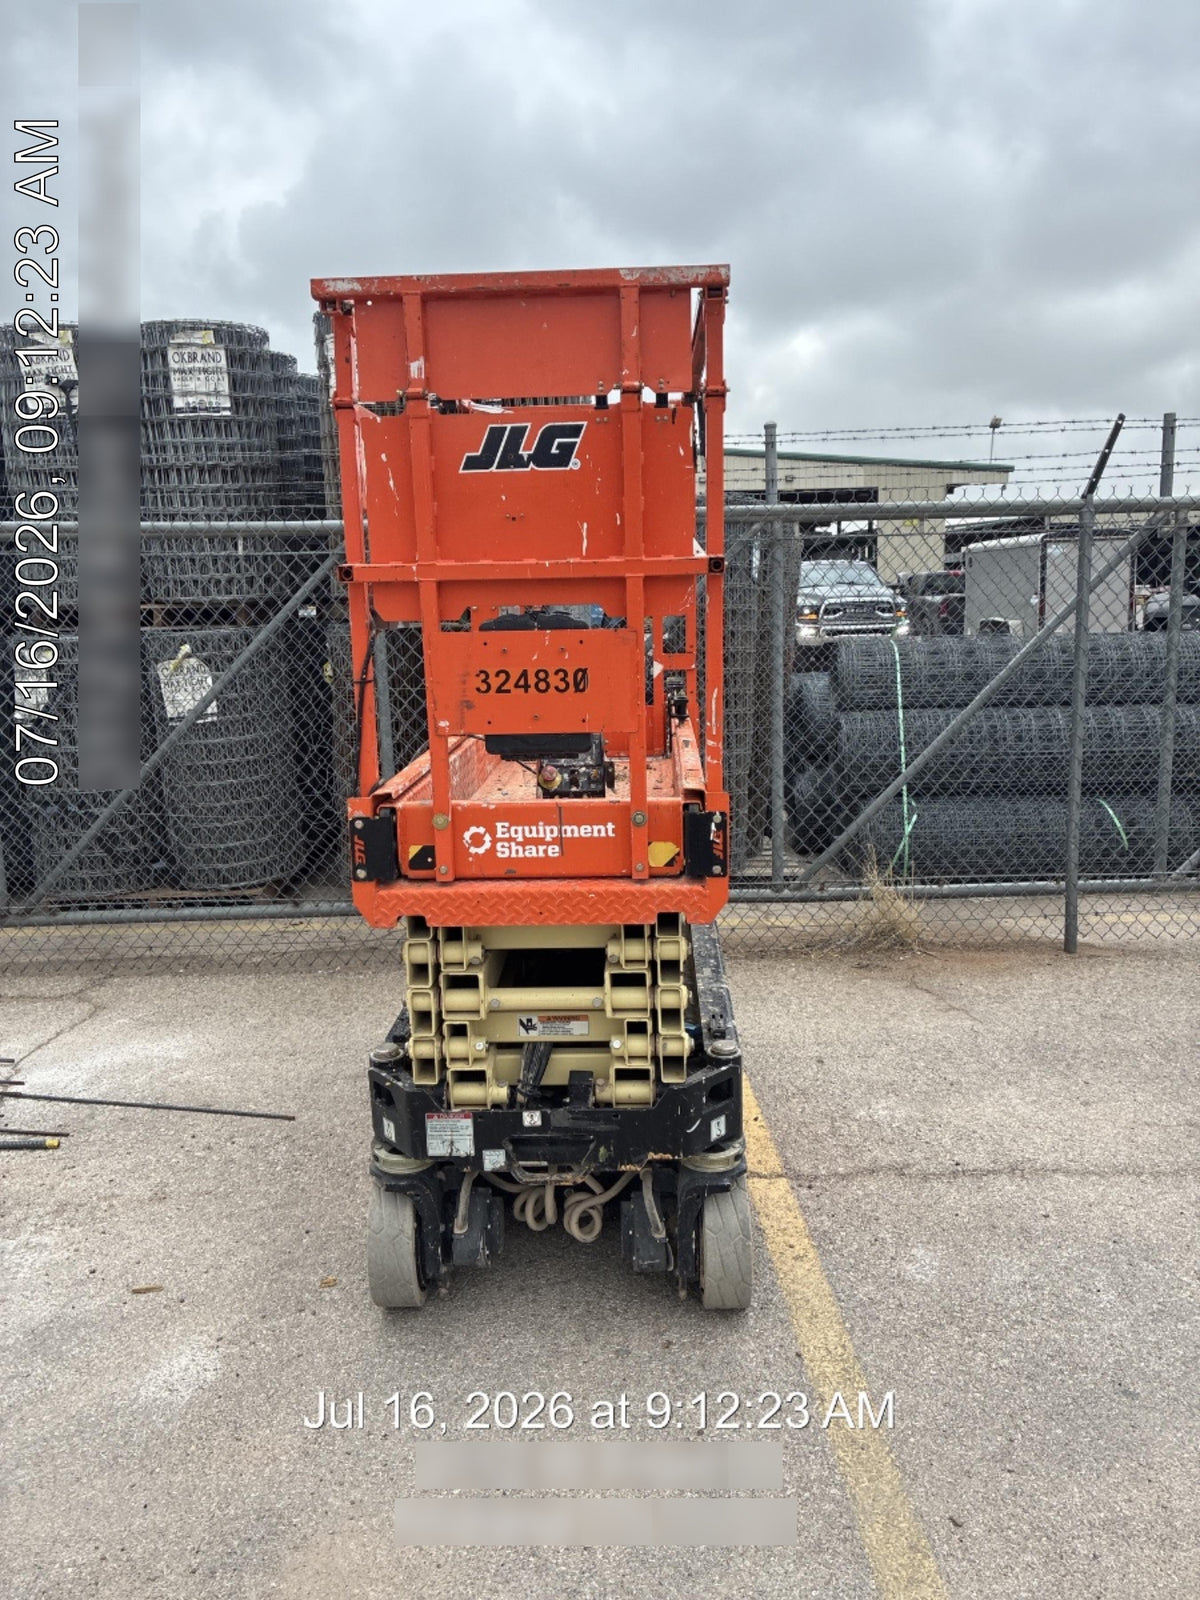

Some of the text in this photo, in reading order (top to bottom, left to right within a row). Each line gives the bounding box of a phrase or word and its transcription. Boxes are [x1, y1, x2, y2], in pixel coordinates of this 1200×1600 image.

[172, 351, 222, 363] OKBRAND
[459, 421, 587, 473] JLG
[475, 667, 589, 694] 324830
[495, 821, 615, 842] Equipment
[354, 834, 367, 865] JLG
[495, 841, 560, 858] Share
